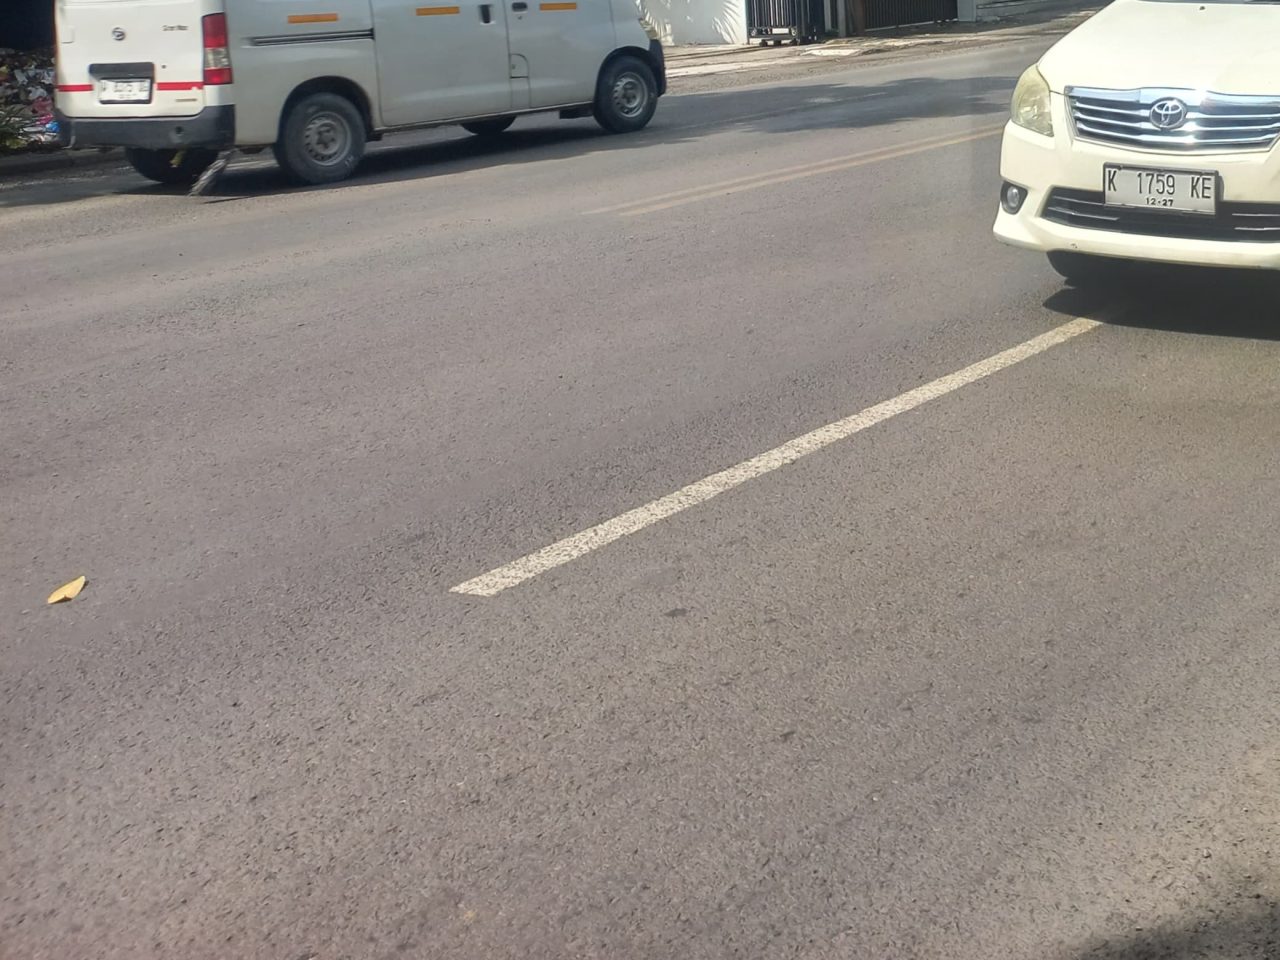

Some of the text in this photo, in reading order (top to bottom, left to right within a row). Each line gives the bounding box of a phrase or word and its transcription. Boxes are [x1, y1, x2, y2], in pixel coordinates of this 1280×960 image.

[1108, 170, 1211, 199] K 1759 KE
